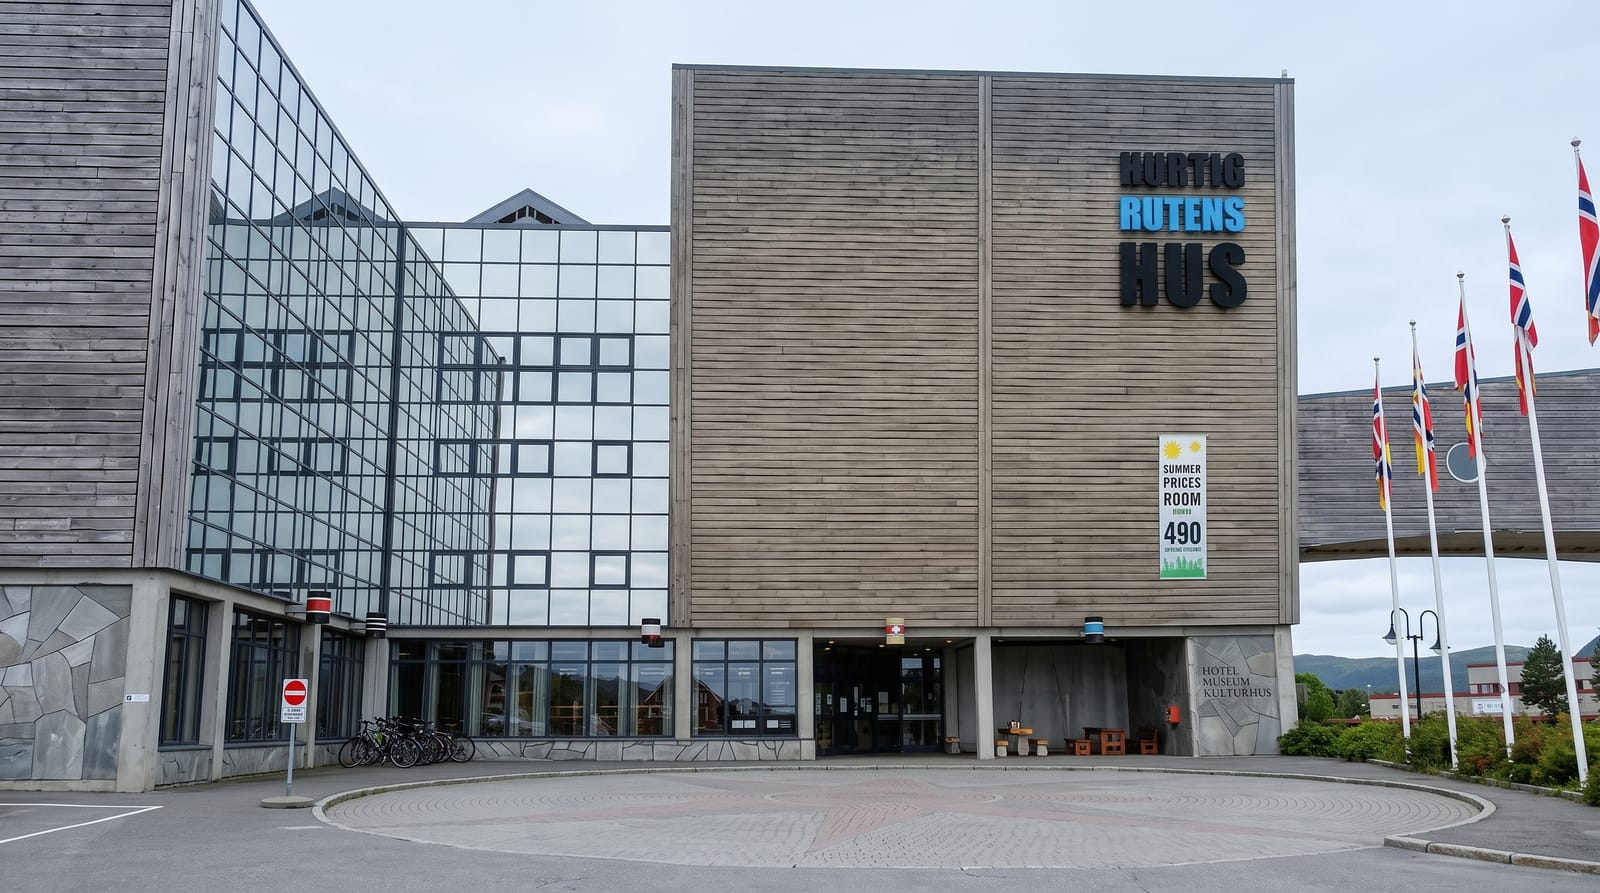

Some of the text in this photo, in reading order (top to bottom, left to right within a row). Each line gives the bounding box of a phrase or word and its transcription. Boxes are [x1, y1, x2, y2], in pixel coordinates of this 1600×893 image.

[1120, 152, 1245, 188] HURTIG
[1119, 196, 1246, 233] RUTENS
[1119, 242, 1247, 308] HUS
[1163, 464, 1201, 474] SUMMER
[1163, 477, 1201, 489] PRICES
[1164, 492, 1201, 506] ROOM
[1164, 521, 1202, 545] 490
[1202, 666, 1239, 676] HOTEL
[1202, 677, 1250, 687] MUSEUM
[1203, 688, 1272, 698] KULTURHUS
